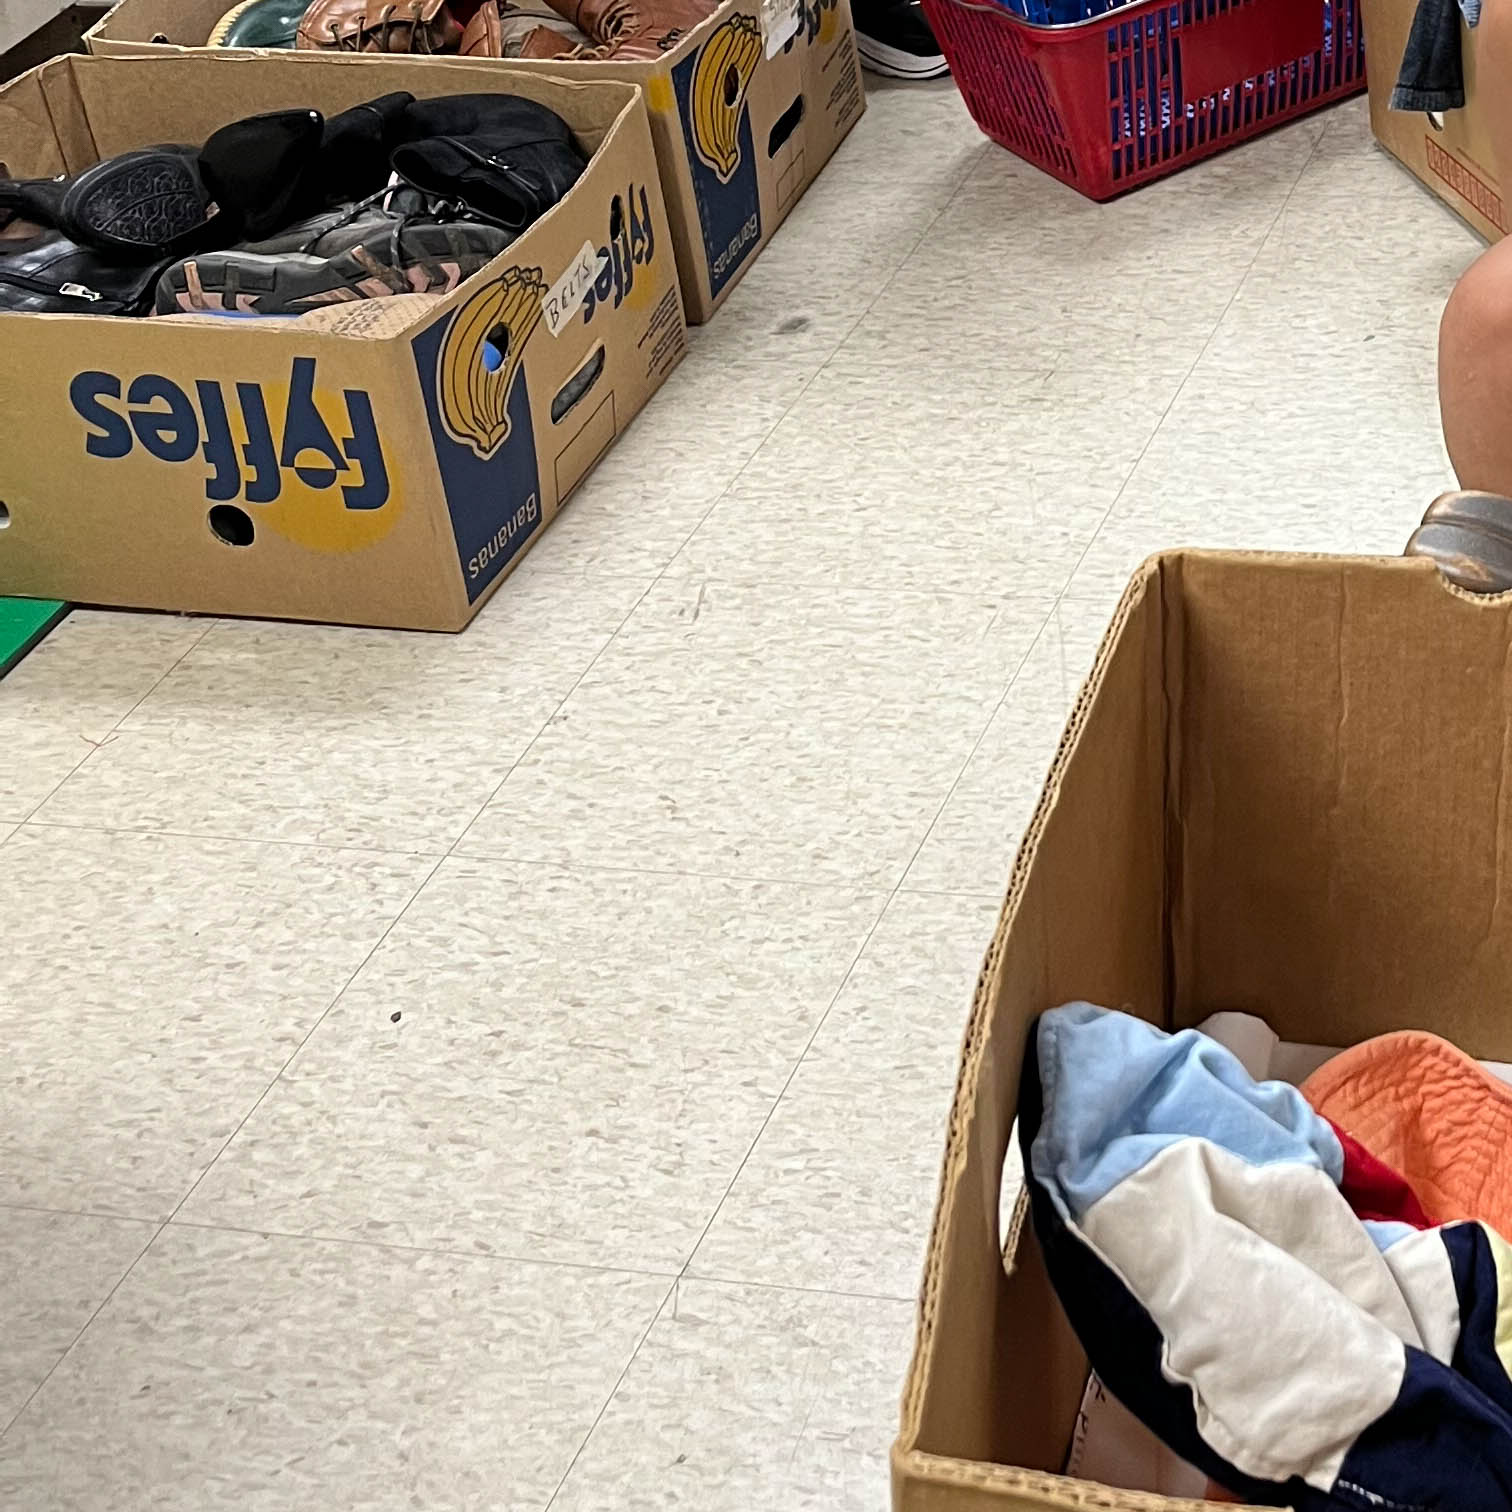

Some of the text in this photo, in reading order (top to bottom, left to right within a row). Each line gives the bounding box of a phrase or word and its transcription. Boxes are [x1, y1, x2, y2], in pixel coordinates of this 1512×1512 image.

[714, 212, 758, 279] Bananas
[545, 254, 592, 330] BELTS
[69, 356, 390, 510] Fyffes
[468, 492, 537, 579] Bananas
